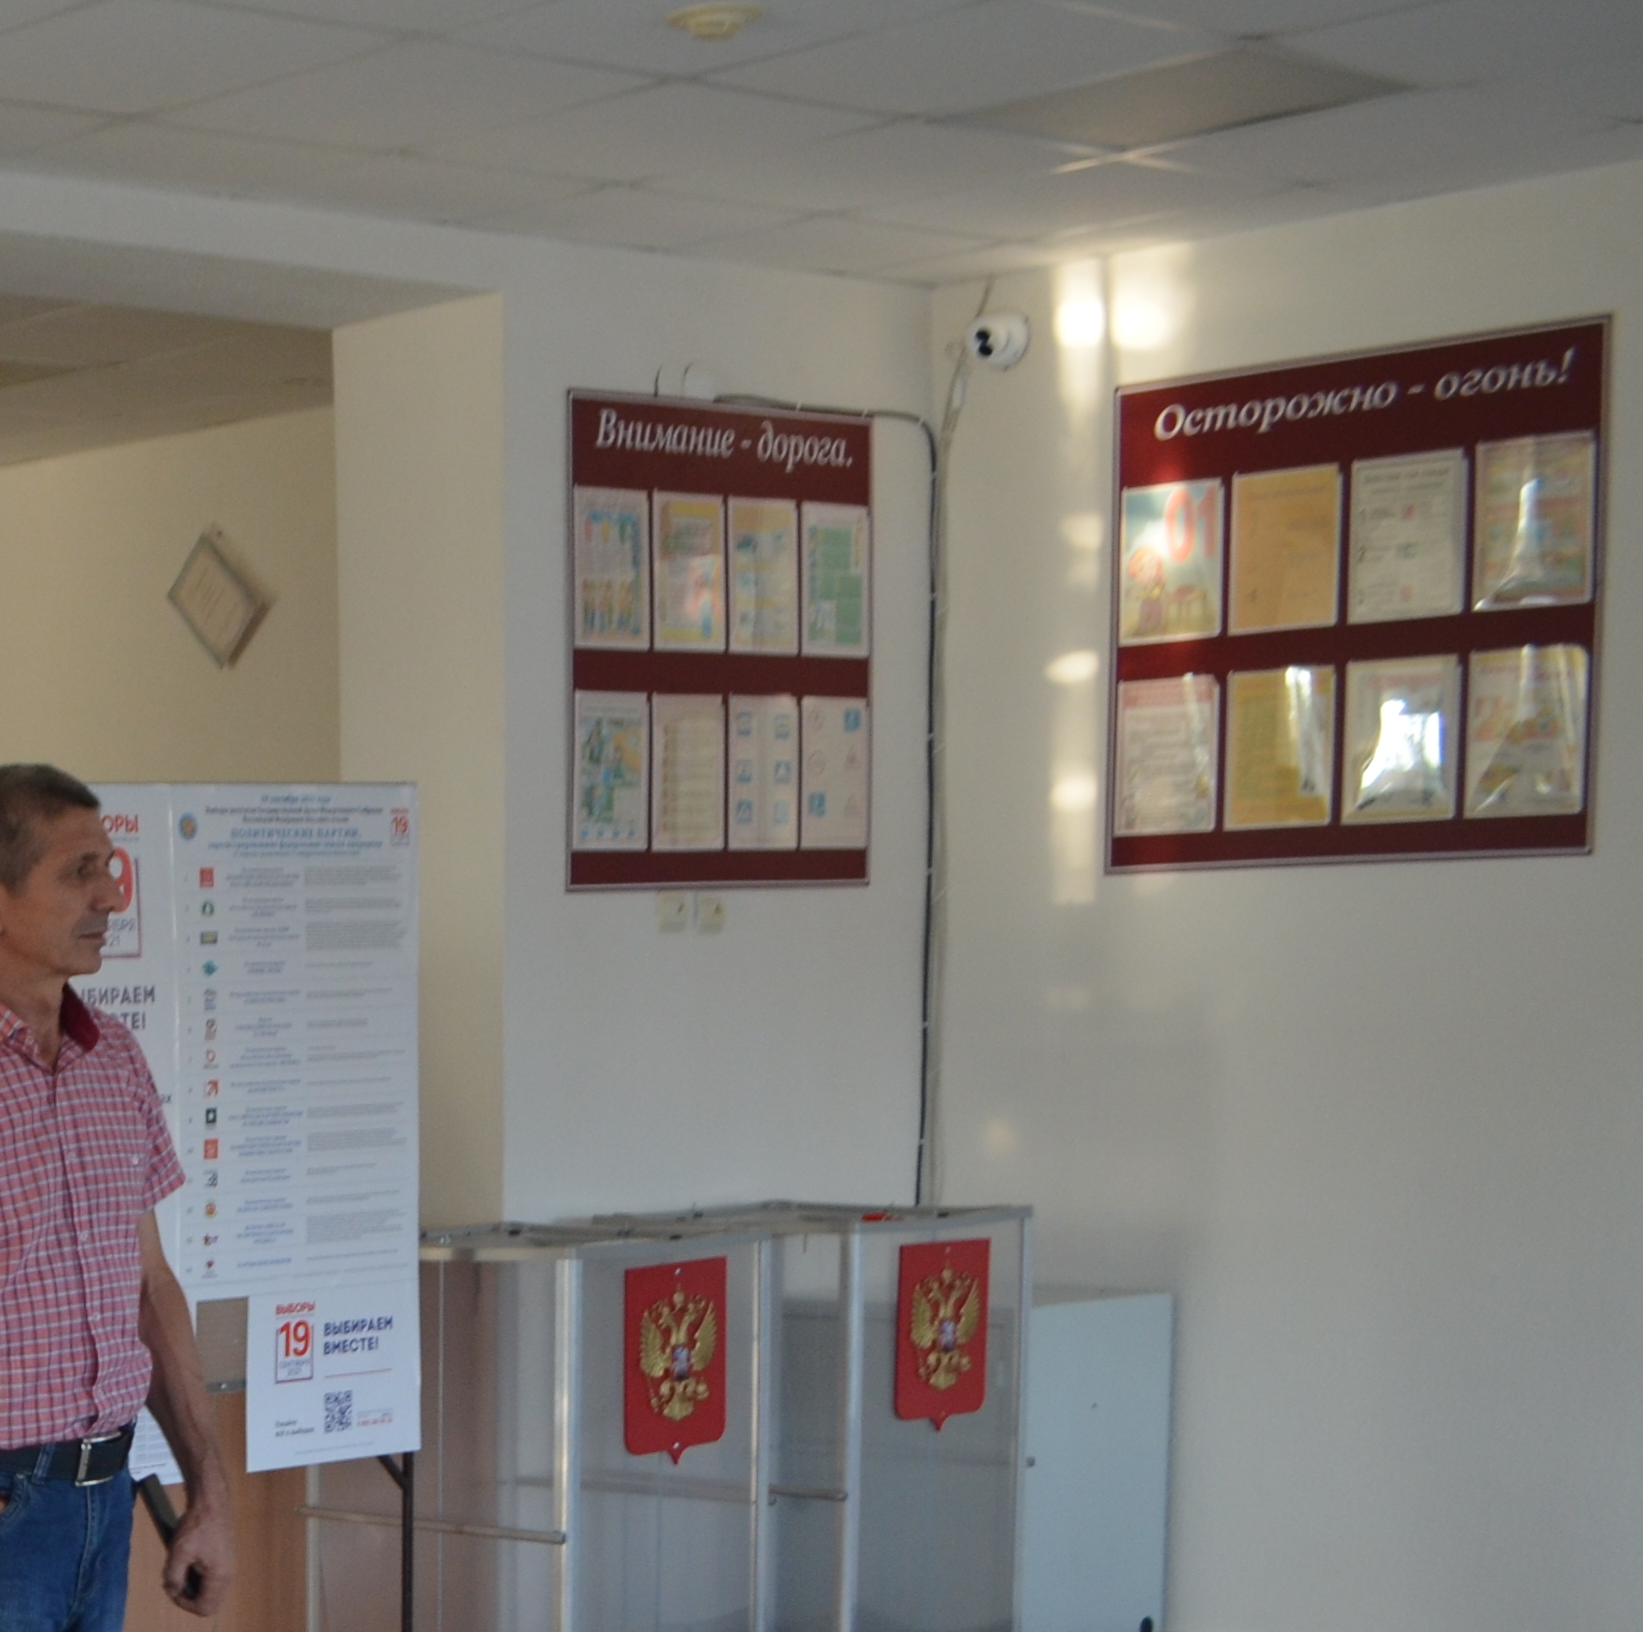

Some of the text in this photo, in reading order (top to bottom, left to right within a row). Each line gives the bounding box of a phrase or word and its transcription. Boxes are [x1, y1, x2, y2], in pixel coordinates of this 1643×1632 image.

[1153, 380, 1400, 442] Осторожно
[1433, 346, 1577, 402] огонь!
[594, 407, 737, 459] Внимание
[756, 419, 854, 474] дорога.
[102, 814, 139, 833] ОРЫ
[108, 847, 133, 914] 9
[82, 985, 155, 1006] БИРАЕМ
[276, 1302, 315, 1314] ВЫБОРЫ
[324, 1316, 393, 1336] ВЫБИРАЕМ
[278, 1319, 311, 1358] 19
[324, 1337, 378, 1355] ВМЕСТЕ!
